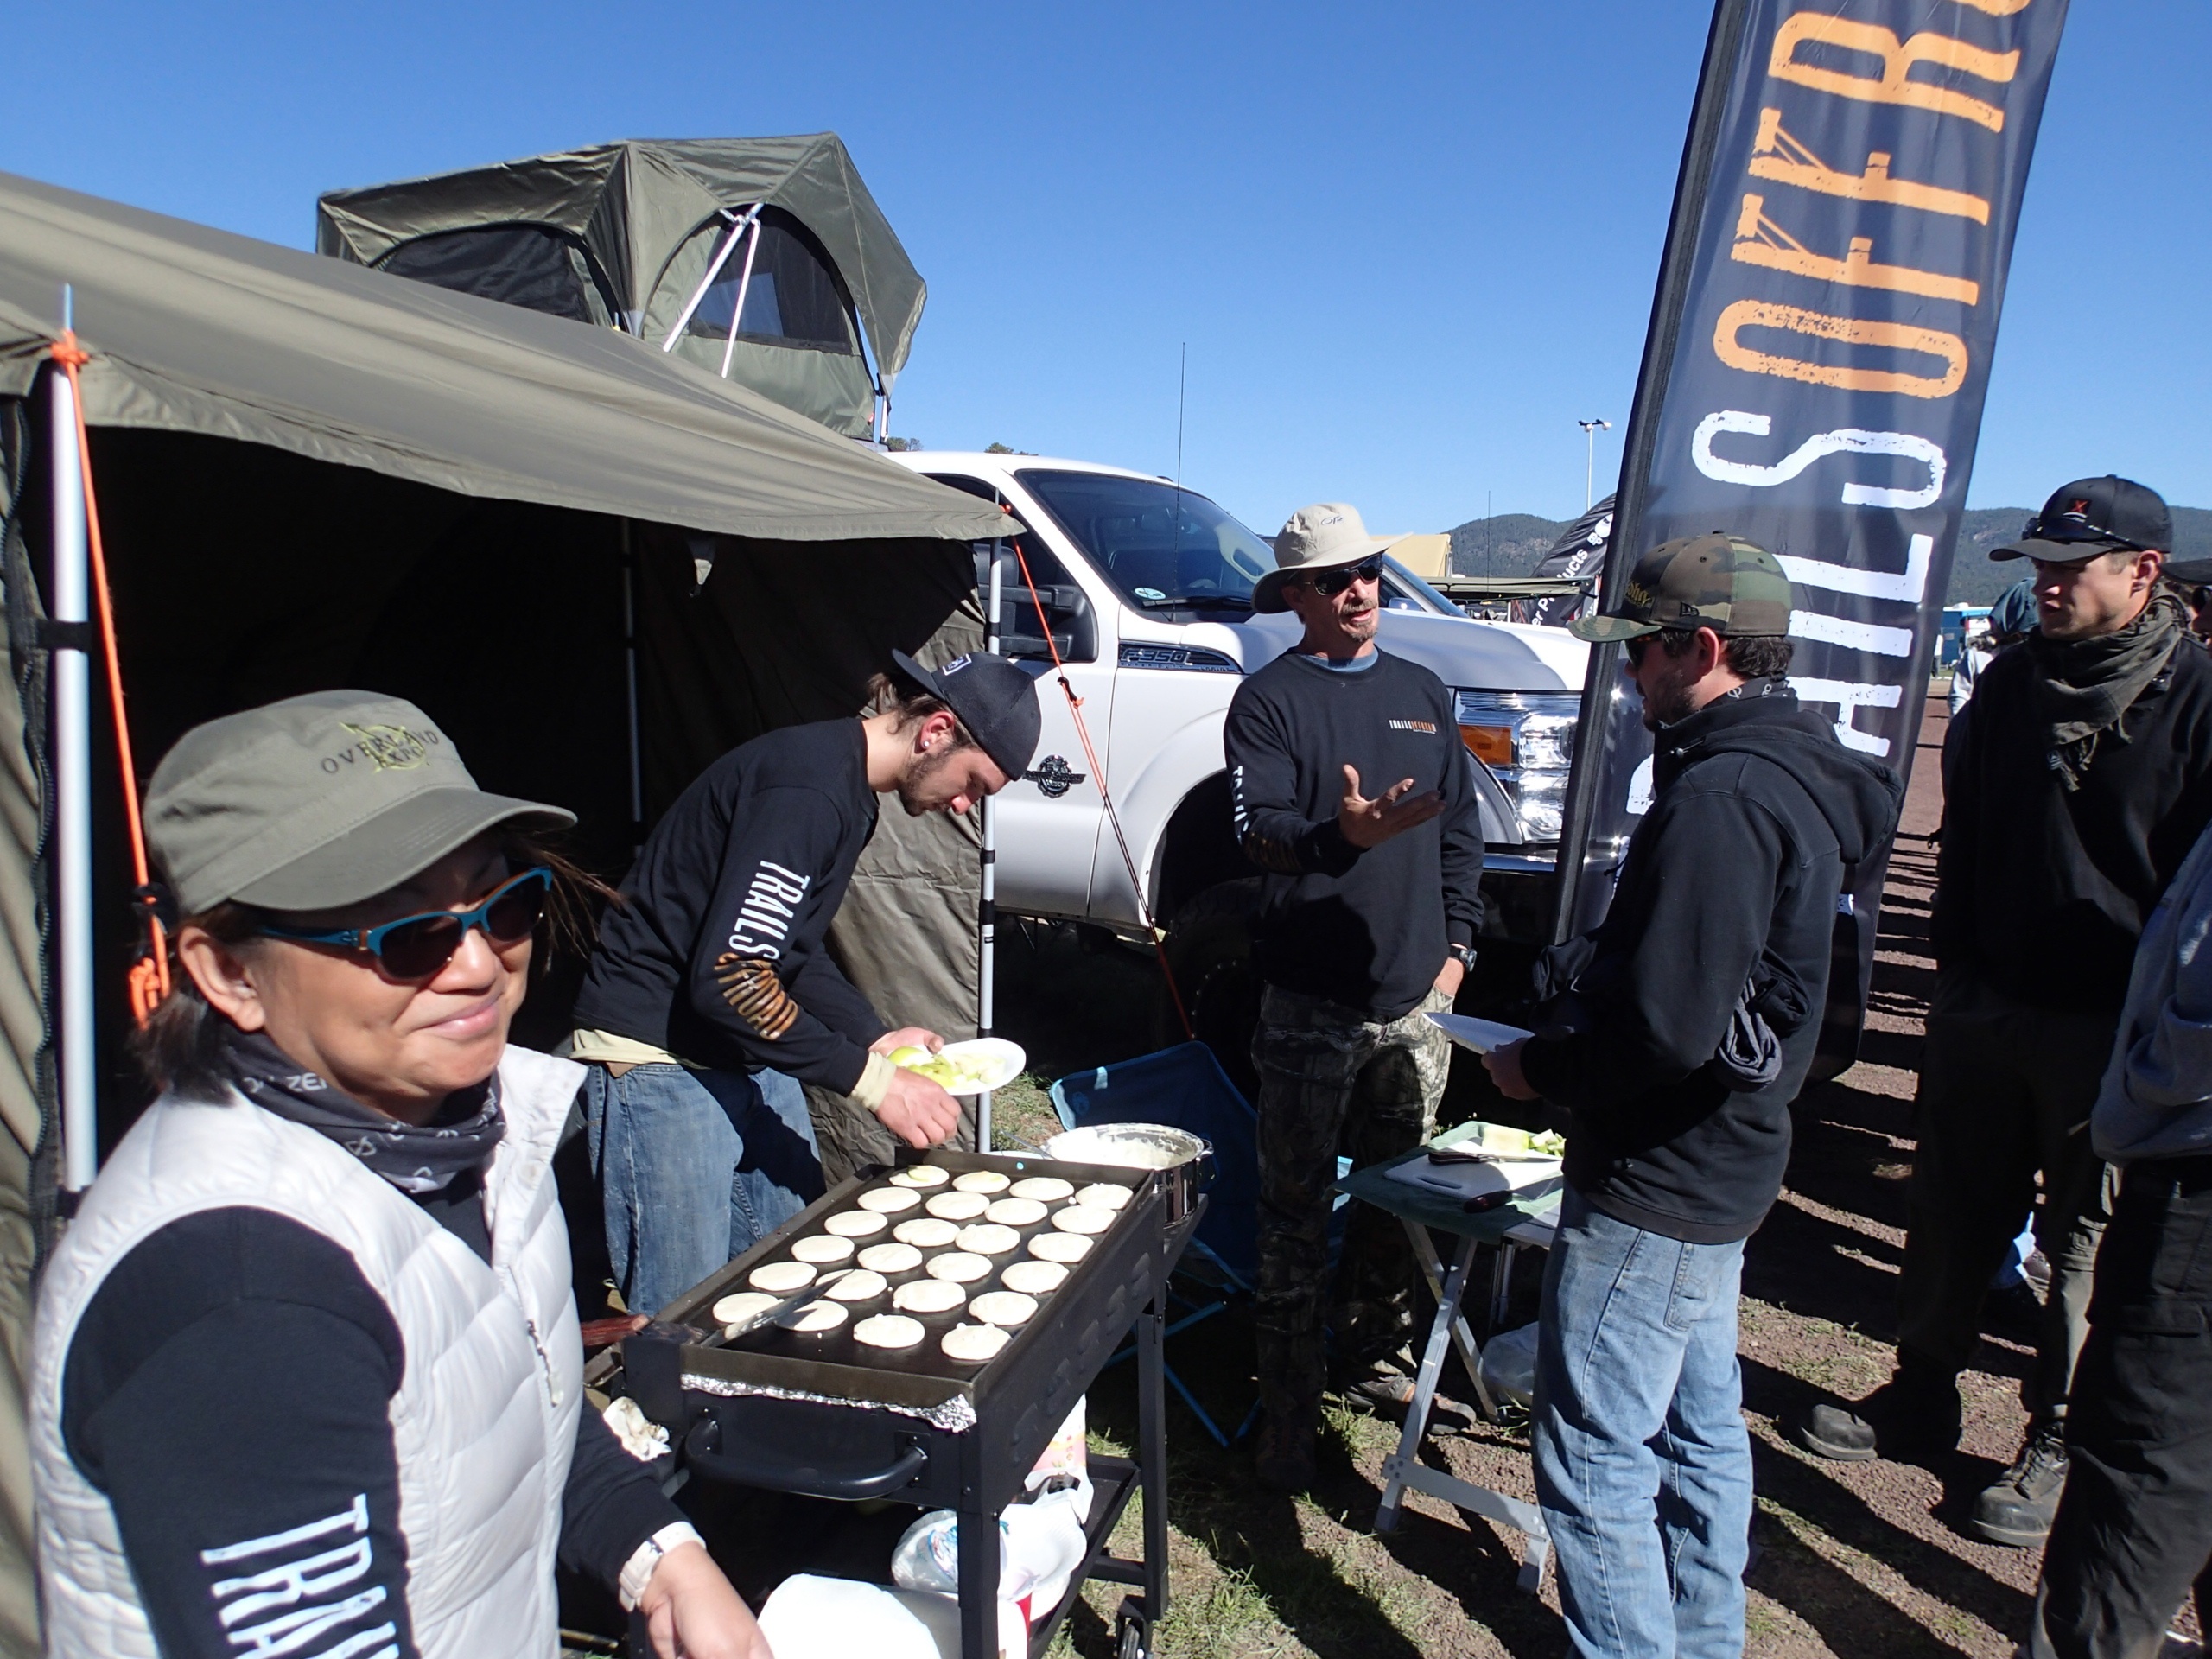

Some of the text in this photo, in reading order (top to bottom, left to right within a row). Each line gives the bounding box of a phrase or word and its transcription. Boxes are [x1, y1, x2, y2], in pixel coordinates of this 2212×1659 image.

[1713, 0, 2029, 400] OFFR
[321, 730, 439, 773] OVERLAND
[728, 860, 810, 960] TRAILS
[200, 1493, 399, 1659] TRA
